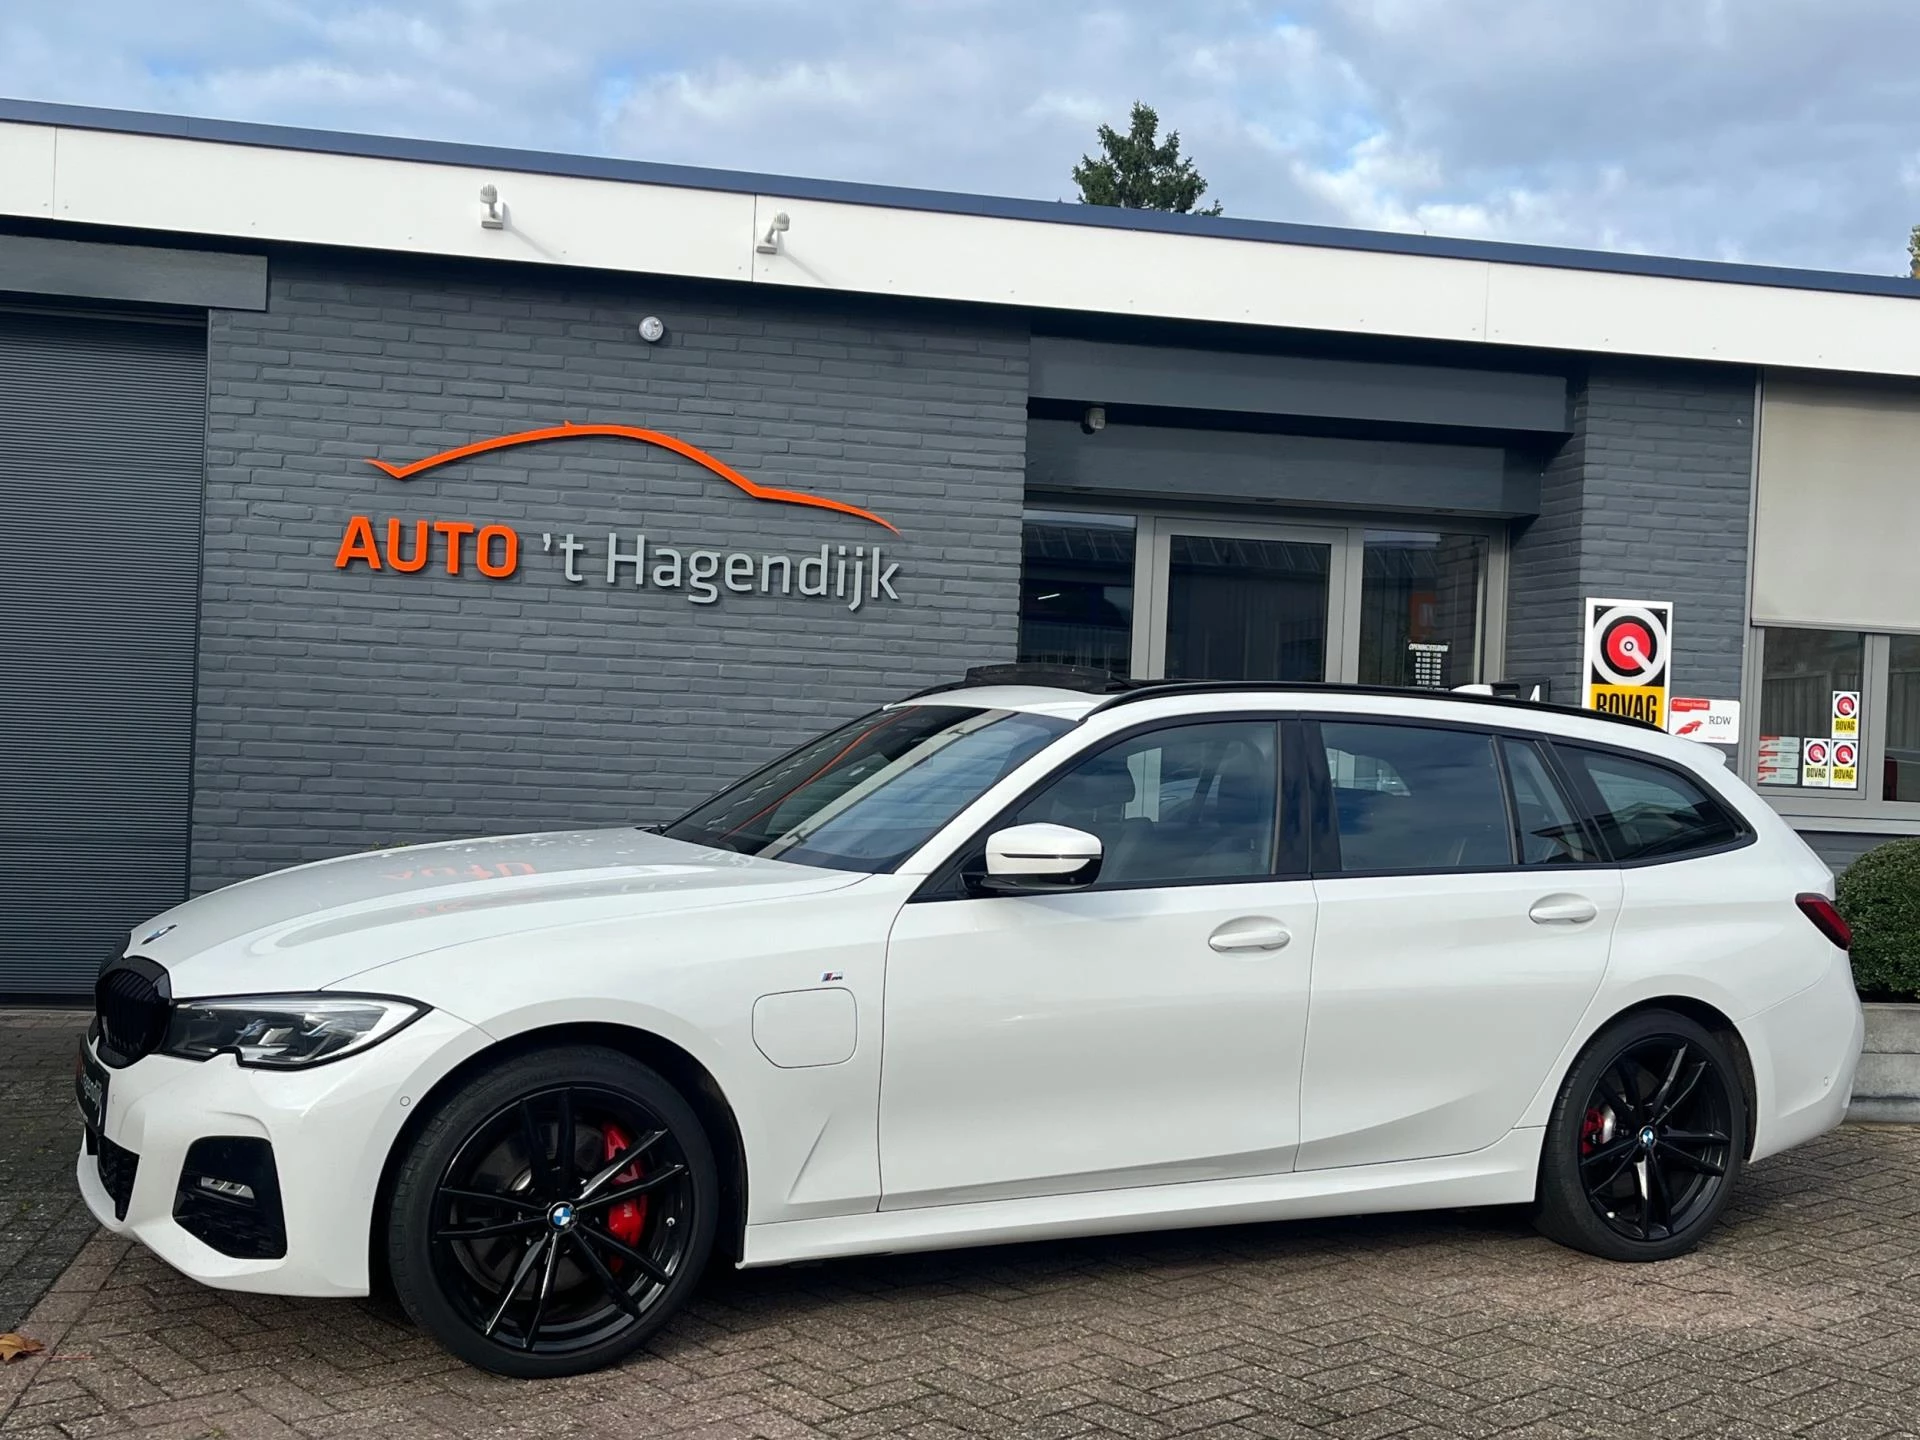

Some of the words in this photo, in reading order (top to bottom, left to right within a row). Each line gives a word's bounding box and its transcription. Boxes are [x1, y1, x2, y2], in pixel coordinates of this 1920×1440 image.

[334, 515, 519, 578] AUTO
[606, 532, 901, 612] Hagendijk
[1708, 715, 1732, 726] RDW
[1835, 720, 1855, 731] BOVAG
[1806, 767, 1826, 778] BOVAG
[1833, 768, 1854, 780] BOVAG
